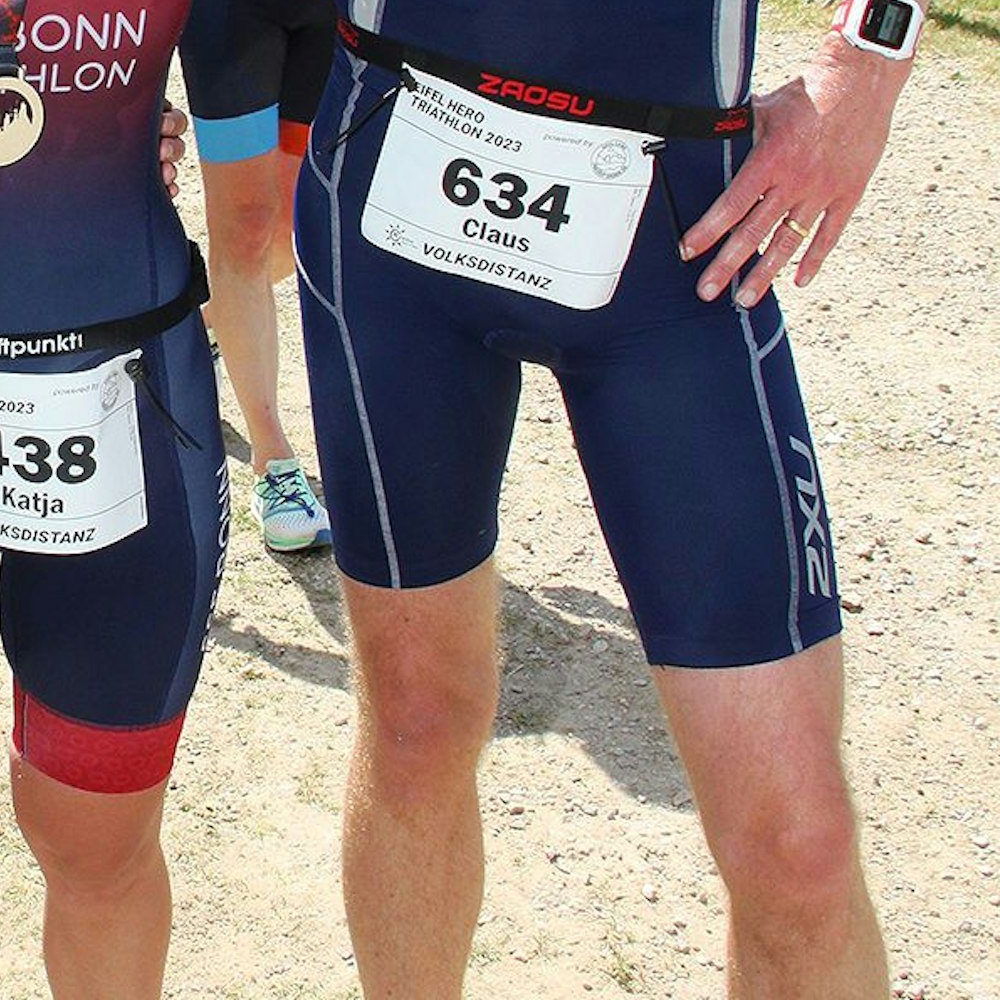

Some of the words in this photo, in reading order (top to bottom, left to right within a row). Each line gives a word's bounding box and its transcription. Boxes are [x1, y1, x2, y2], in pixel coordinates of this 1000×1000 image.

[415, 82, 446, 106] EIFEL
[447, 99, 485, 124] HERO
[477, 72, 596, 116] ZAOSU
[411, 94, 483, 139] TRIATHLON
[485, 131, 523, 153] 2023
[442, 158, 570, 233] 634
[462, 218, 531, 253] Claus
[423, 242, 553, 291] VOLKSDISTANZ
[2, 486, 64, 518] Katja
